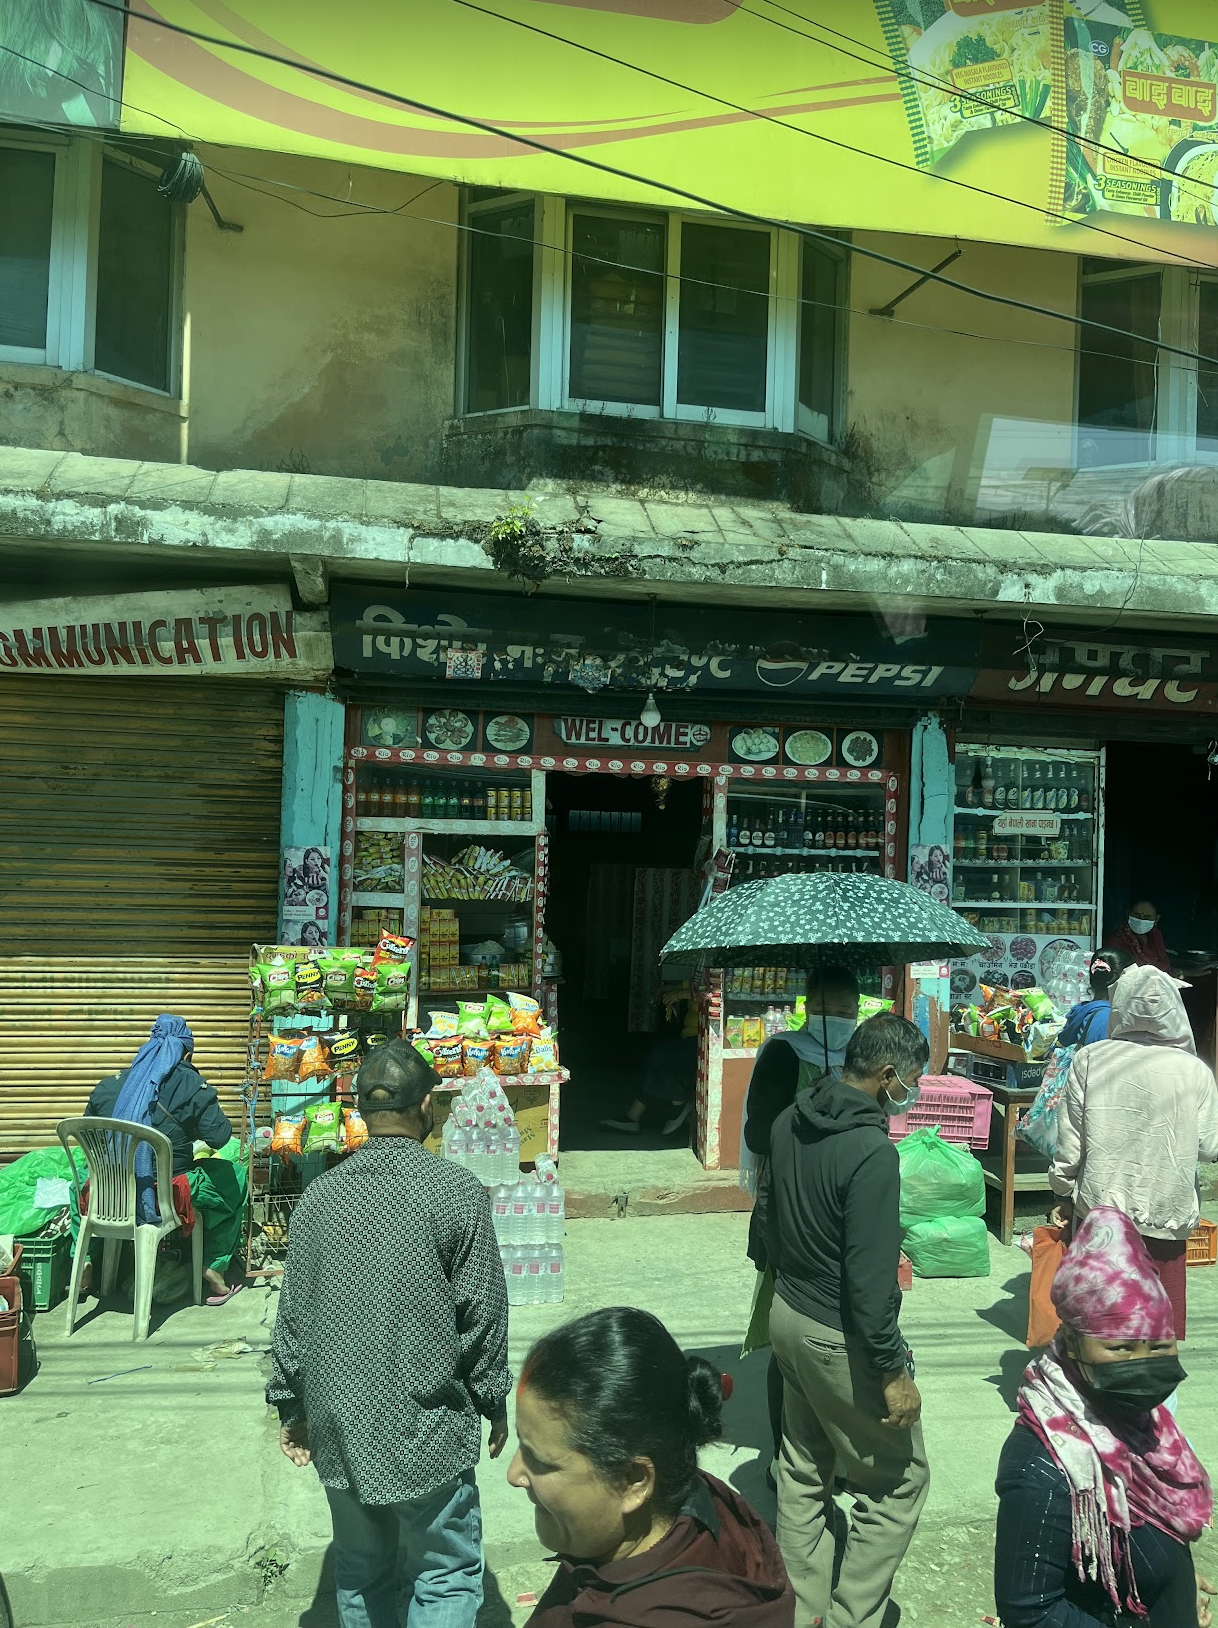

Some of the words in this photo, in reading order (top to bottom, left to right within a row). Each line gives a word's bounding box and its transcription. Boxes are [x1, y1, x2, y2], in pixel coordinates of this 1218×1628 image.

[1090, 44, 1108, 52] CG
[964, 68, 982, 77] MASALA
[982, 62, 1008, 73] FLAVOURED
[964, 75, 983, 86] INSTANT
[983, 72, 1004, 82] NOODLES
[949, 94, 961, 113] 3
[1110, 164, 1131, 173] INSTANT
[1094, 174, 1107, 191] 3
[1106, 179, 1156, 193] SEASONINGS
[807, 662, 944, 687] PEPSI
[563, 718, 689, 746] WEL-COME
[1009, 816, 1024, 828] नेपाली
[334, 1041, 354, 1052] PENNY
[1021, 1067, 1041, 1080] pepsi
